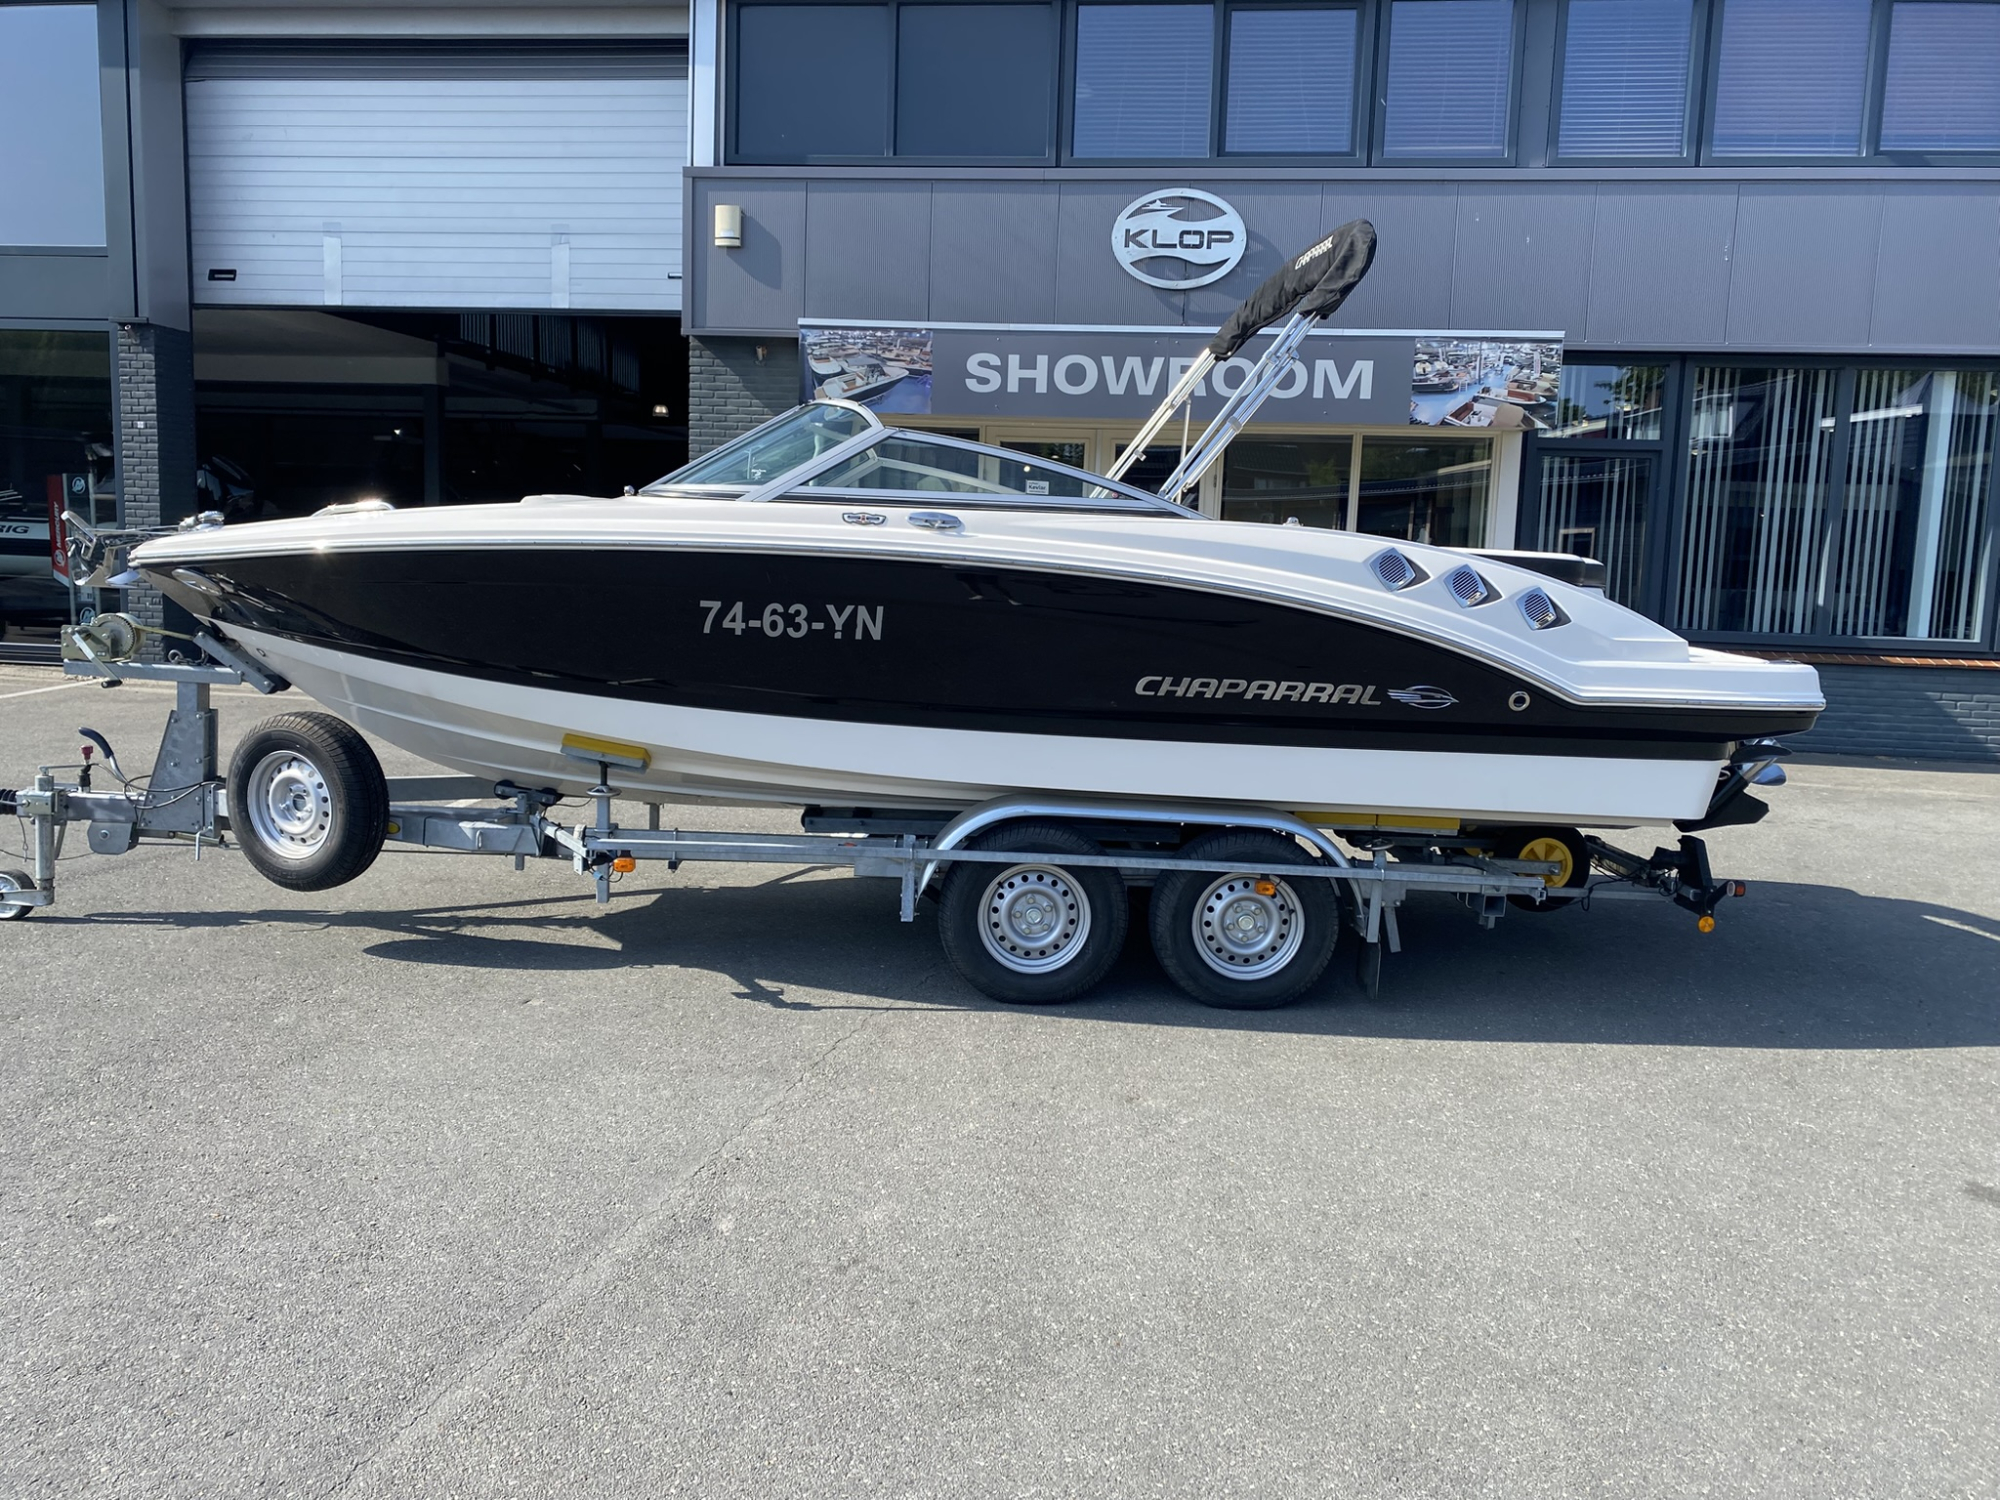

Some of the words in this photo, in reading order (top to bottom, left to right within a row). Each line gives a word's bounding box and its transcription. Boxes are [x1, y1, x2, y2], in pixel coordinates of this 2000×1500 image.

[1124, 228, 1234, 249] KLOP
[965, 352, 1374, 400] SHOWROOM
[53, 501, 62, 549] MERCURY
[700, 600, 884, 640] 74-63-YN
[1135, 676, 1381, 705] CHAPARRAL
